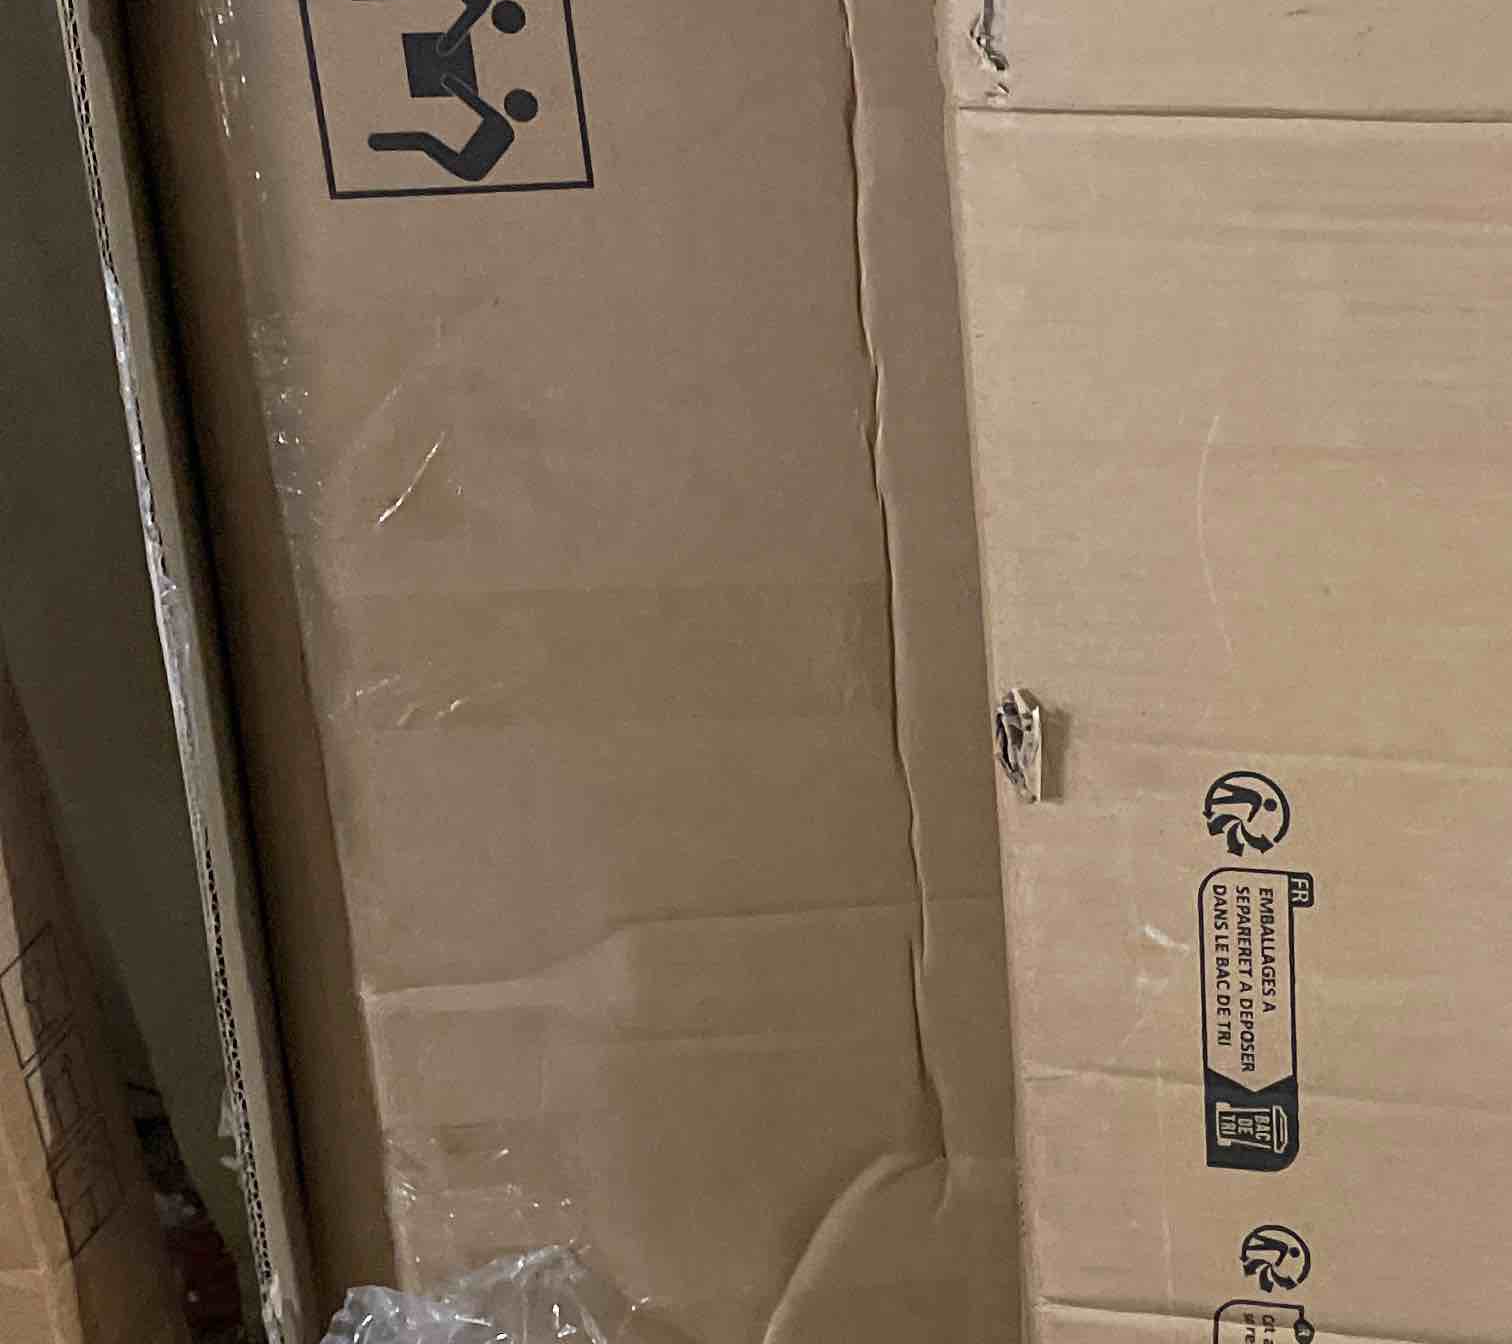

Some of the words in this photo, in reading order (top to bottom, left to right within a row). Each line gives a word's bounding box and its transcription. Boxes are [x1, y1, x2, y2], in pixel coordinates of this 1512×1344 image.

[1290, 877, 1308, 903] FR
[1211, 884, 1228, 930] DANS
[1213, 934, 1228, 952] LE
[1235, 885, 1252, 976] SEPARERET
[1258, 887, 1275, 996] EMBALLAGES
[1214, 956, 1229, 990] BAC
[1238, 980, 1252, 993] A
[1215, 996, 1229, 1016] DE
[1261, 1000, 1274, 1013] A
[1216, 1020, 1230, 1046] TRI
[1238, 998, 1255, 1072] DEPOSER
[1253, 1115, 1270, 1142] BAC
